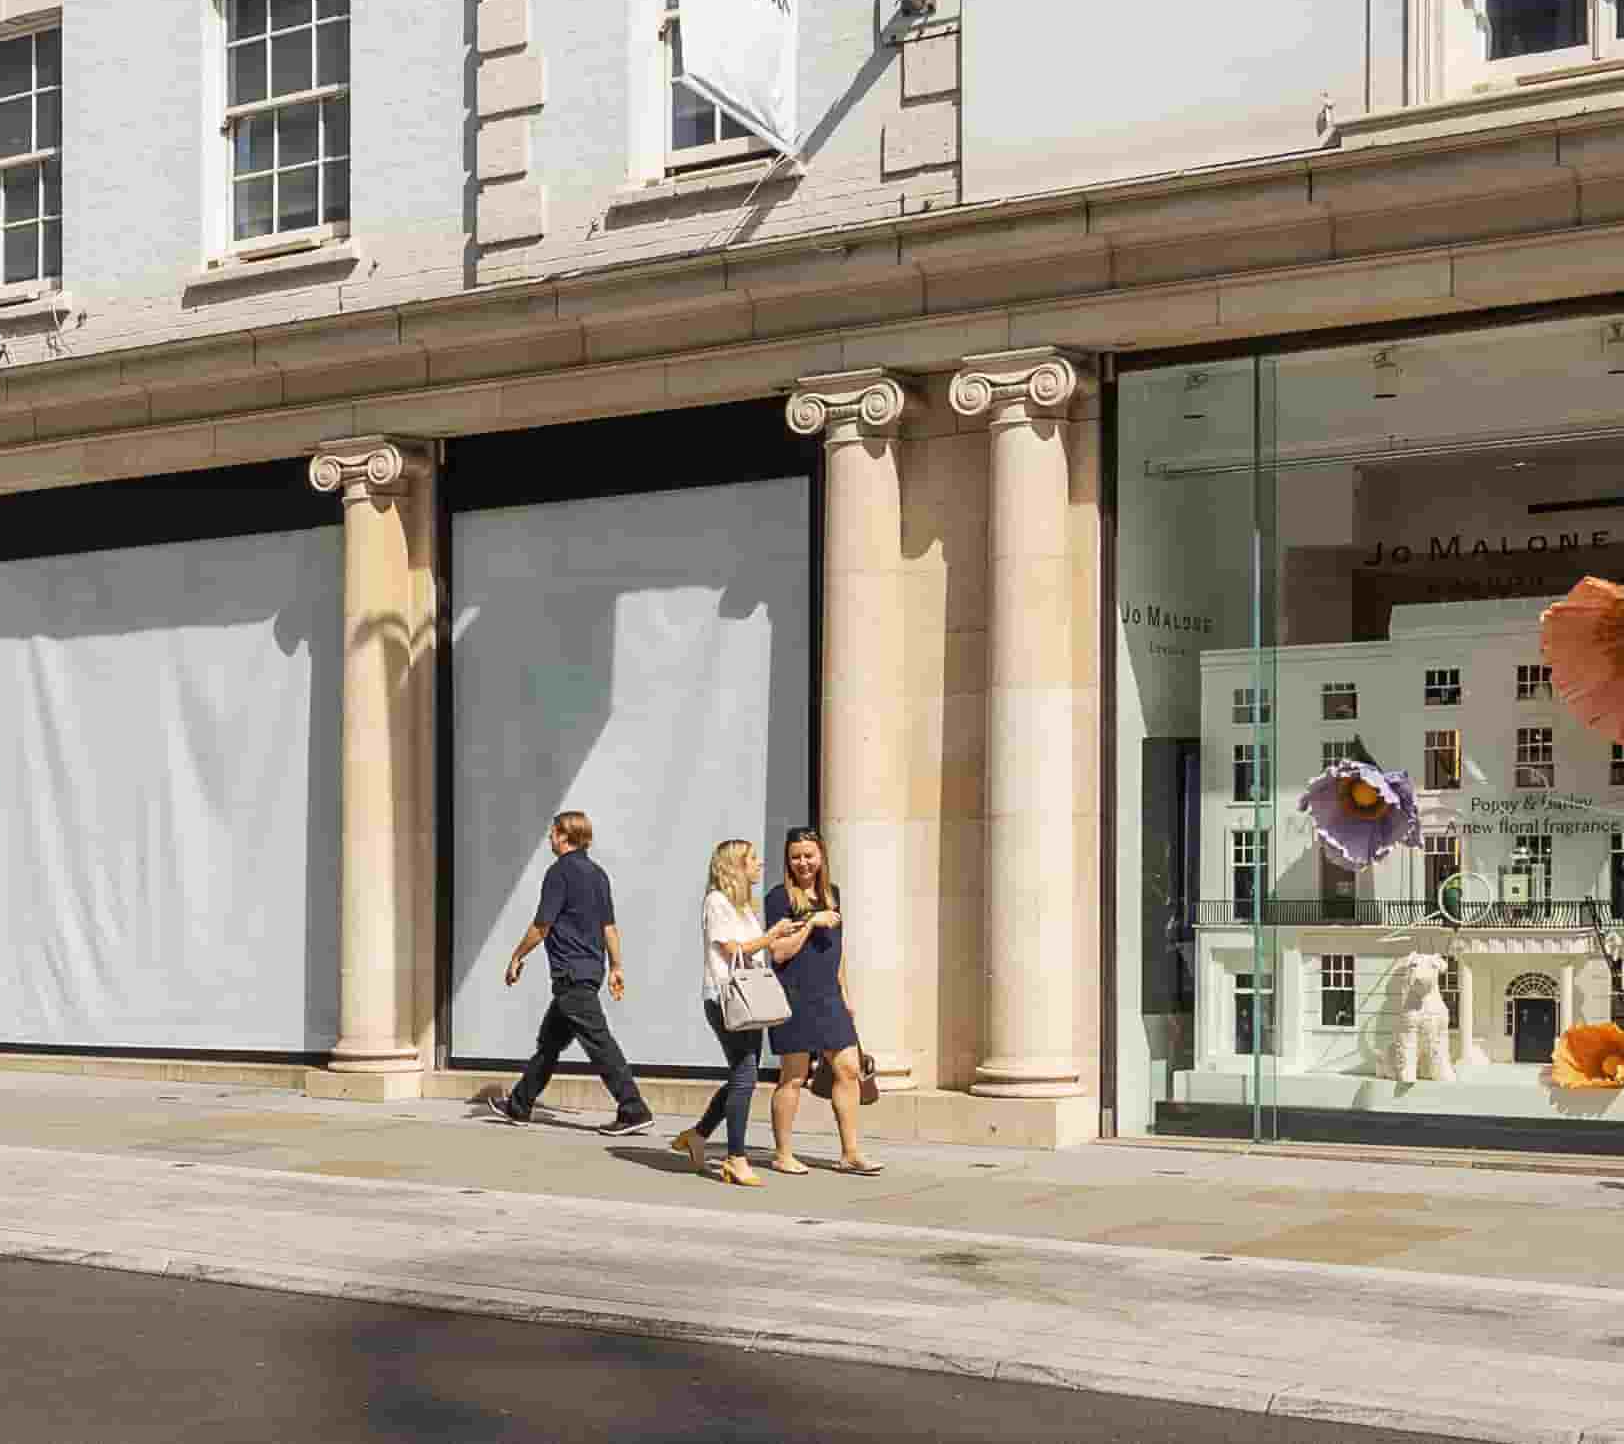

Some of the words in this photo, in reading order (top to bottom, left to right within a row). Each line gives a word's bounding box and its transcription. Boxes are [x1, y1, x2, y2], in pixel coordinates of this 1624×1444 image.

[1471, 797, 1519, 815] Poppy
[1445, 819, 1459, 834] A
[1463, 821, 1494, 834] new
[1499, 815, 1539, 834] floral
[1543, 817, 1621, 838] fragrance
